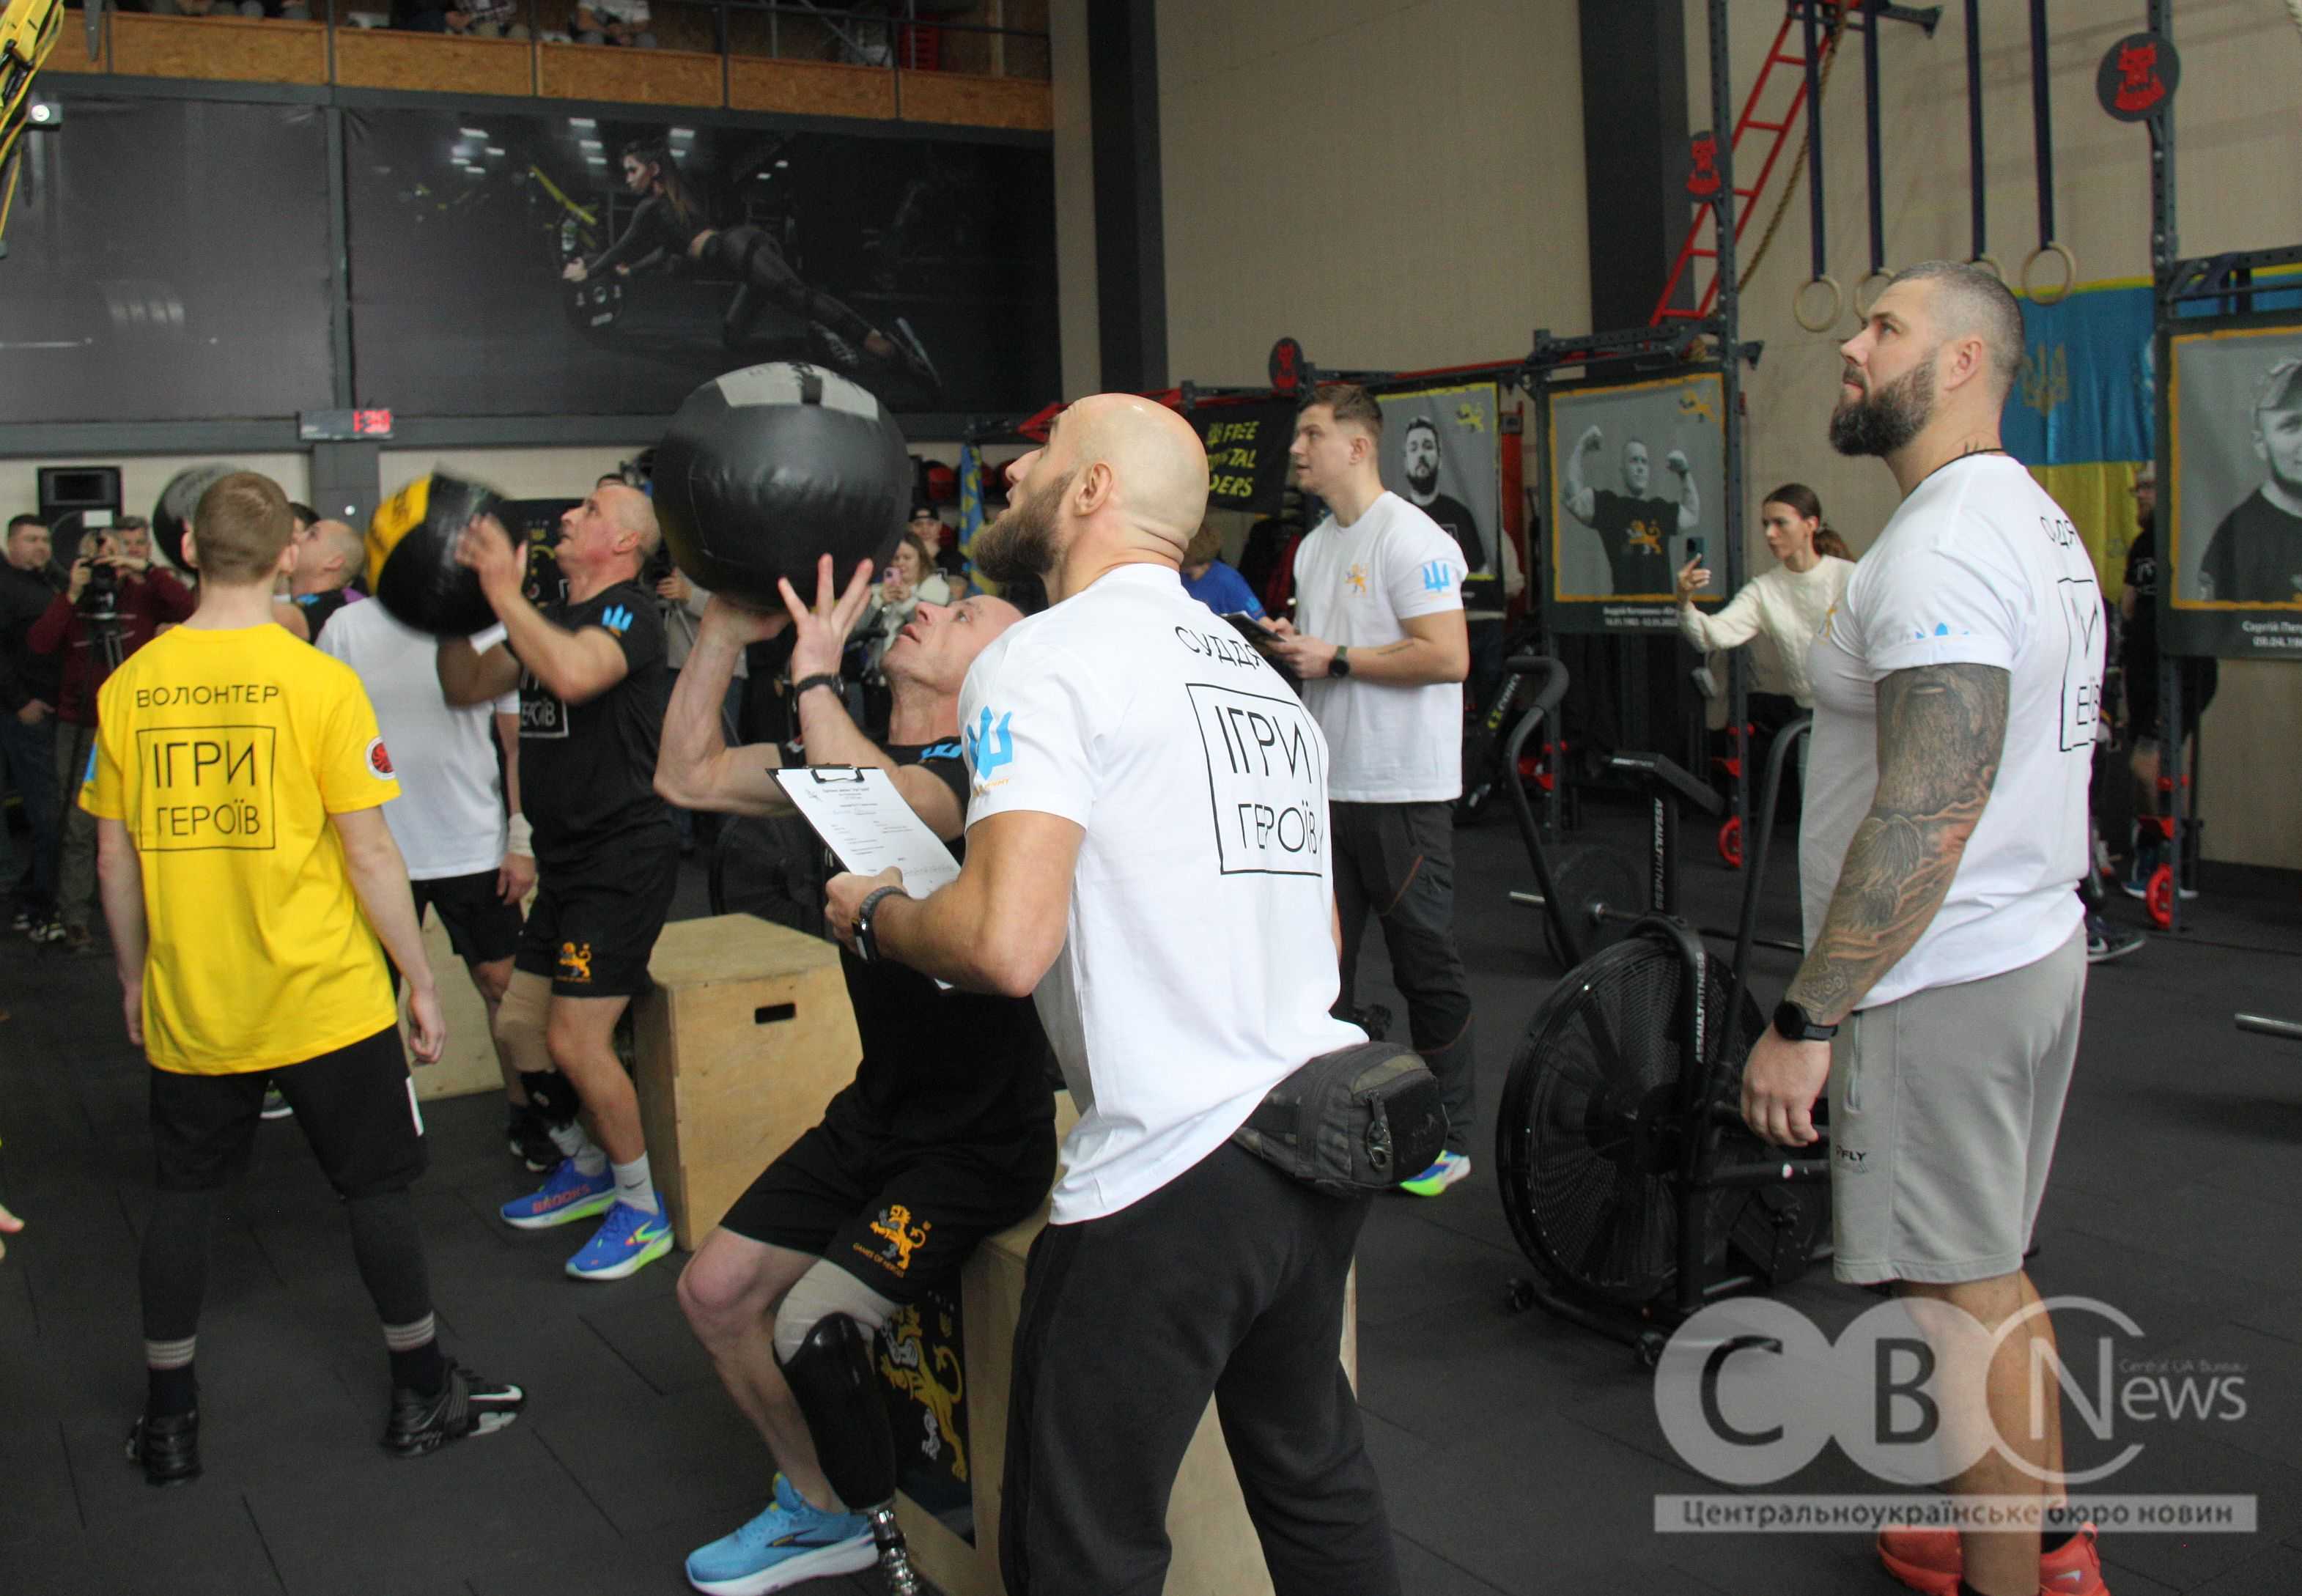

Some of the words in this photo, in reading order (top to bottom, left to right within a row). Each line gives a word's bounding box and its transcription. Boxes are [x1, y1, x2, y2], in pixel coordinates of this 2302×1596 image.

[1222, 421, 1260, 443] FREE
[136, 684, 279, 709] ВОЛОНТЕР
[153, 740, 257, 789] ІГРИ
[1214, 705, 1313, 785] ІГРИ
[156, 799, 260, 836] ГЕРОЇВ
[1237, 799, 1318, 855] ГЕРОЇВ
